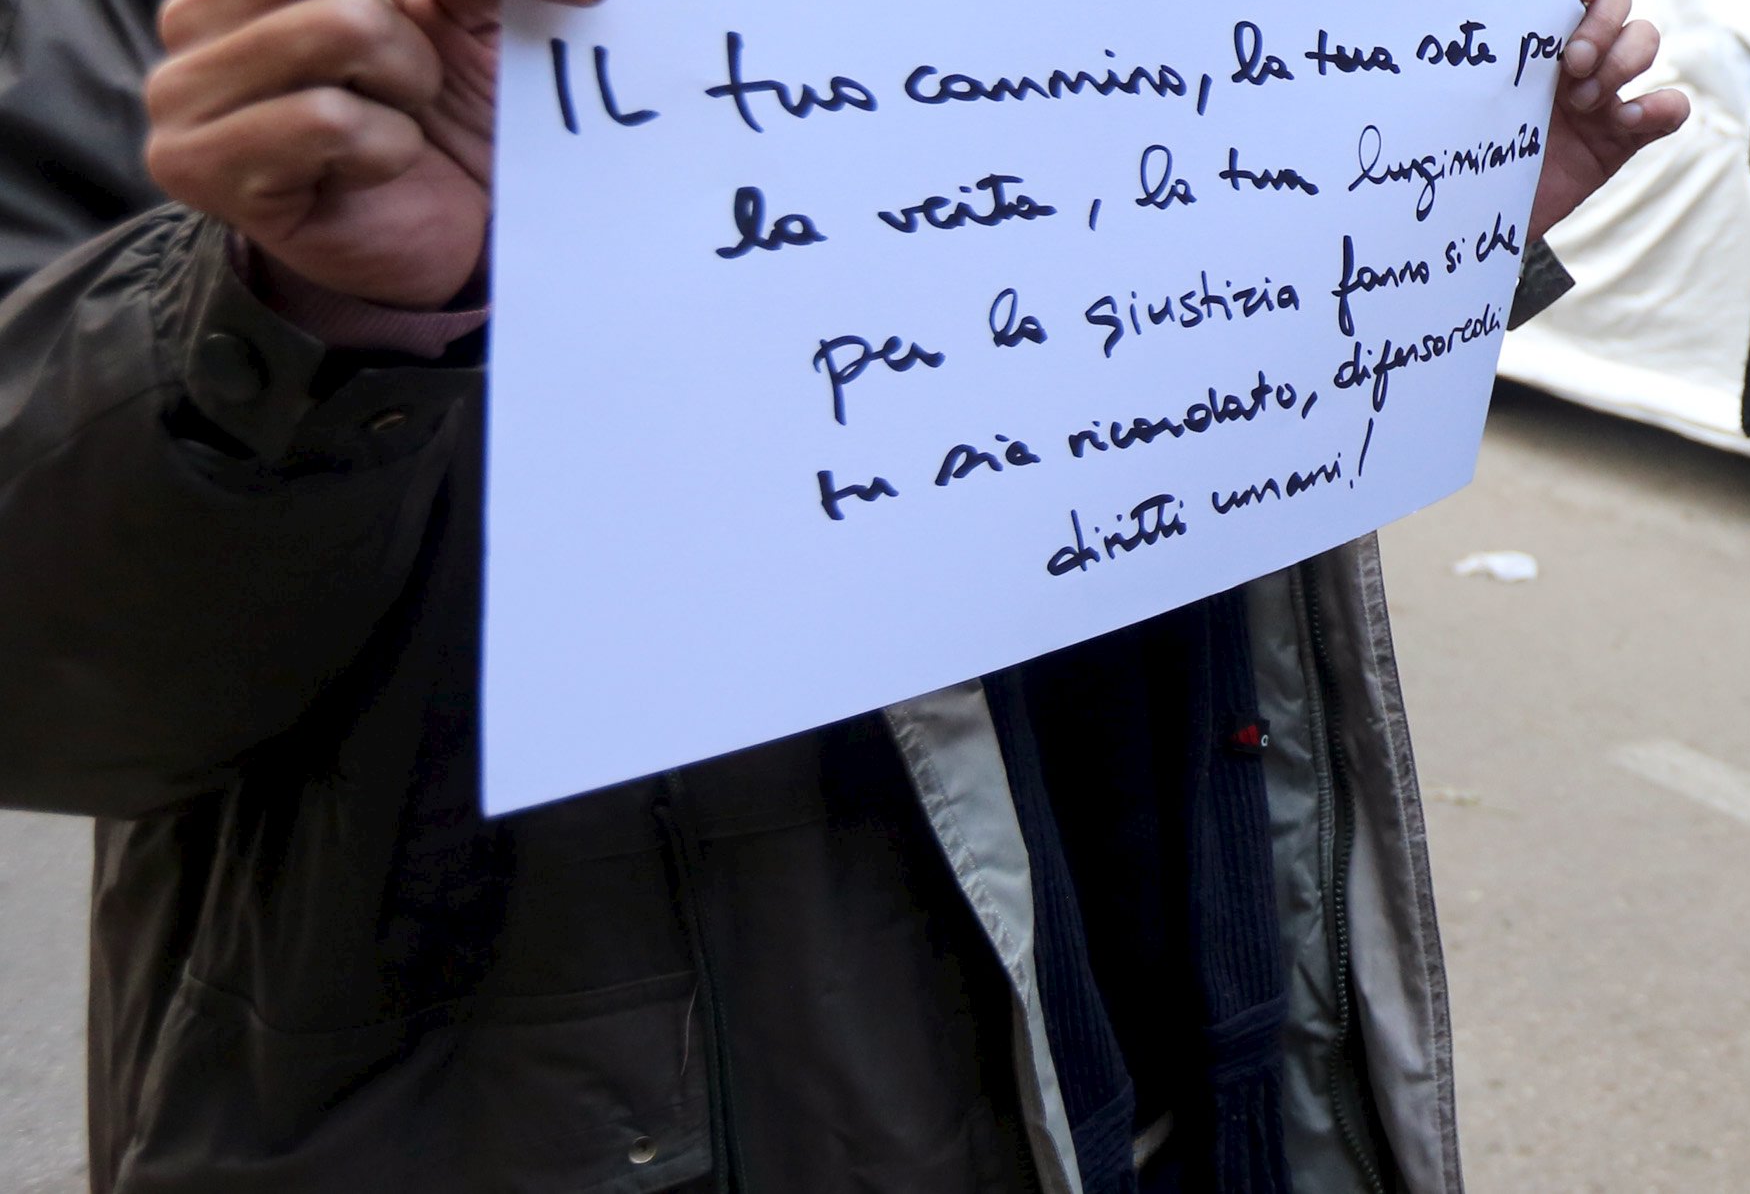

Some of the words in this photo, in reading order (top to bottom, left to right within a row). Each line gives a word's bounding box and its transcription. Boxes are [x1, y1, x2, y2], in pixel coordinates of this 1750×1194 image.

[705, 31, 877, 133] tuo
[904, 49, 1212, 116] cammino,
[1231, 21, 1294, 85] la
[1305, 29, 1400, 75] tua
[715, 186, 828, 259] la
[1135, 145, 1197, 210] la
[1219, 147, 1319, 195] tua
[813, 335, 945, 426] per
[989, 288, 1048, 347] la
[1085, 270, 1299, 358] giustizia
[1331, 235, 1429, 337] fanno
[1476, 212, 1520, 262] che
[817, 470, 899, 520] tu
[1047, 494, 1187, 576] diritti
